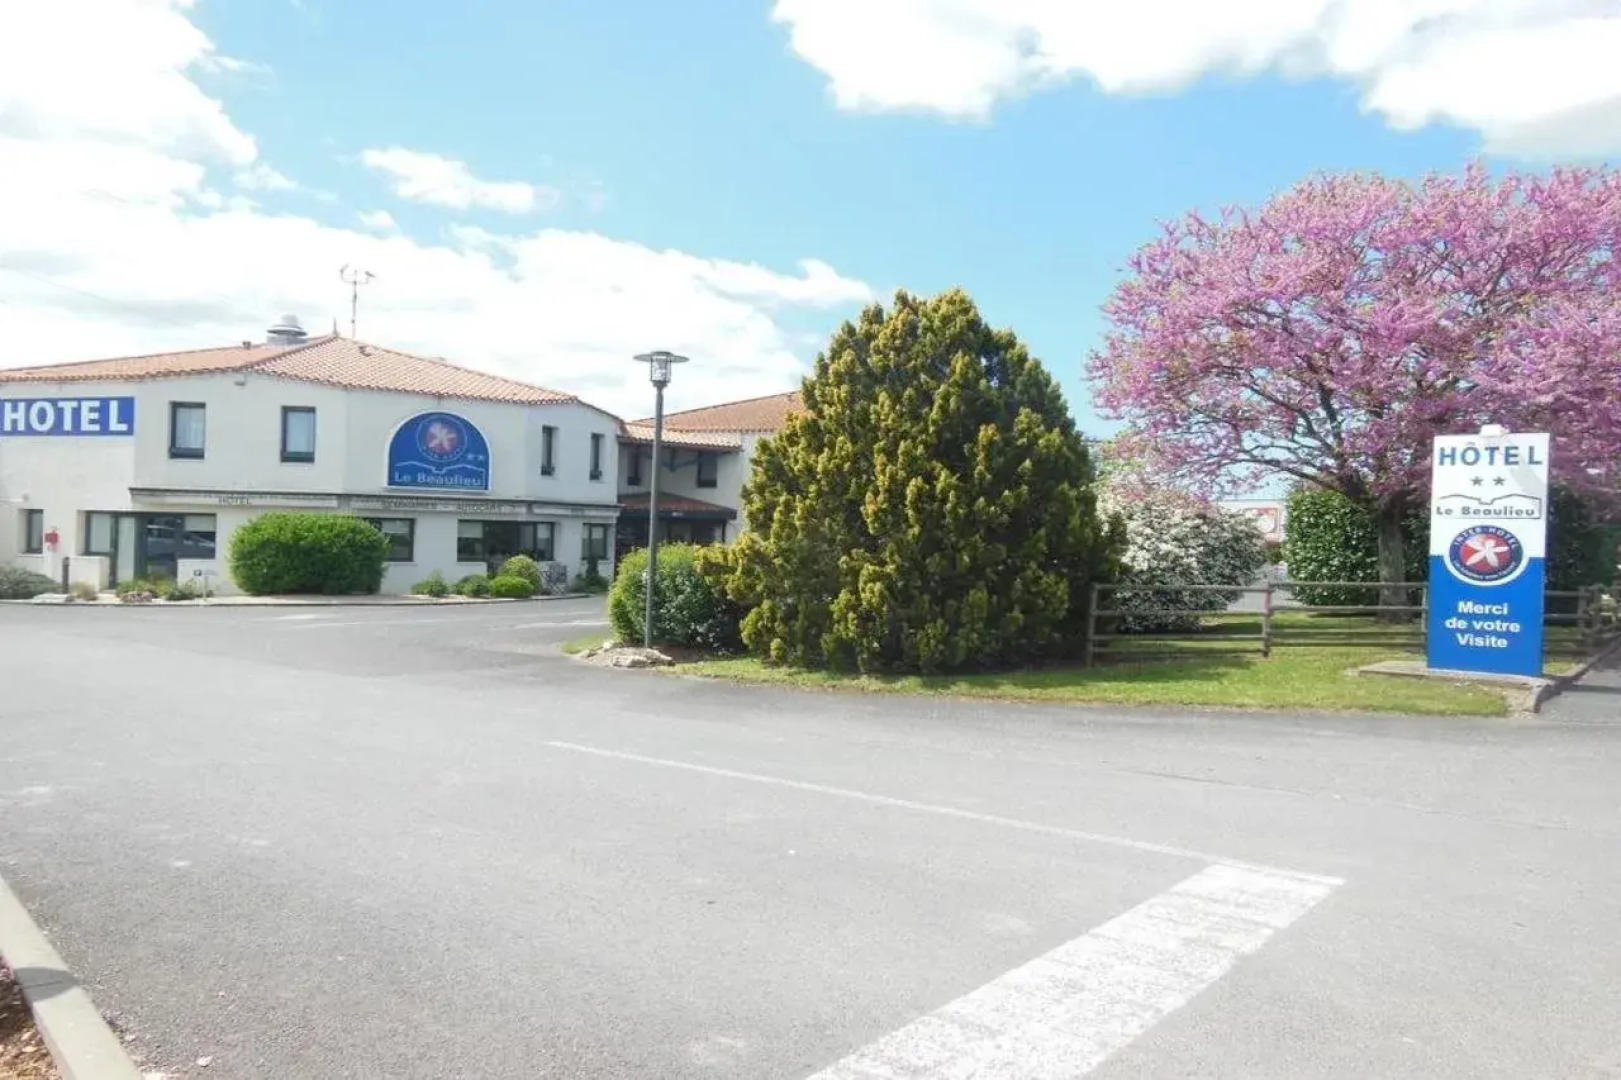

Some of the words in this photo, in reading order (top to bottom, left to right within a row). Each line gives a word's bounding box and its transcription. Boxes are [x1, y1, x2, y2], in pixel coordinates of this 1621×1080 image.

[3, 399, 128, 432] HOTEL
[395, 471, 411, 482] Le
[417, 472, 482, 486] Beaulieu
[1436, 505, 1453, 516] Le
[1461, 505, 1535, 517] Beaulieu
[1457, 601, 1508, 615] Merci
[1445, 616, 1468, 630] de
[1472, 620, 1520, 633] votre
[1457, 633, 1508, 648] Visite
